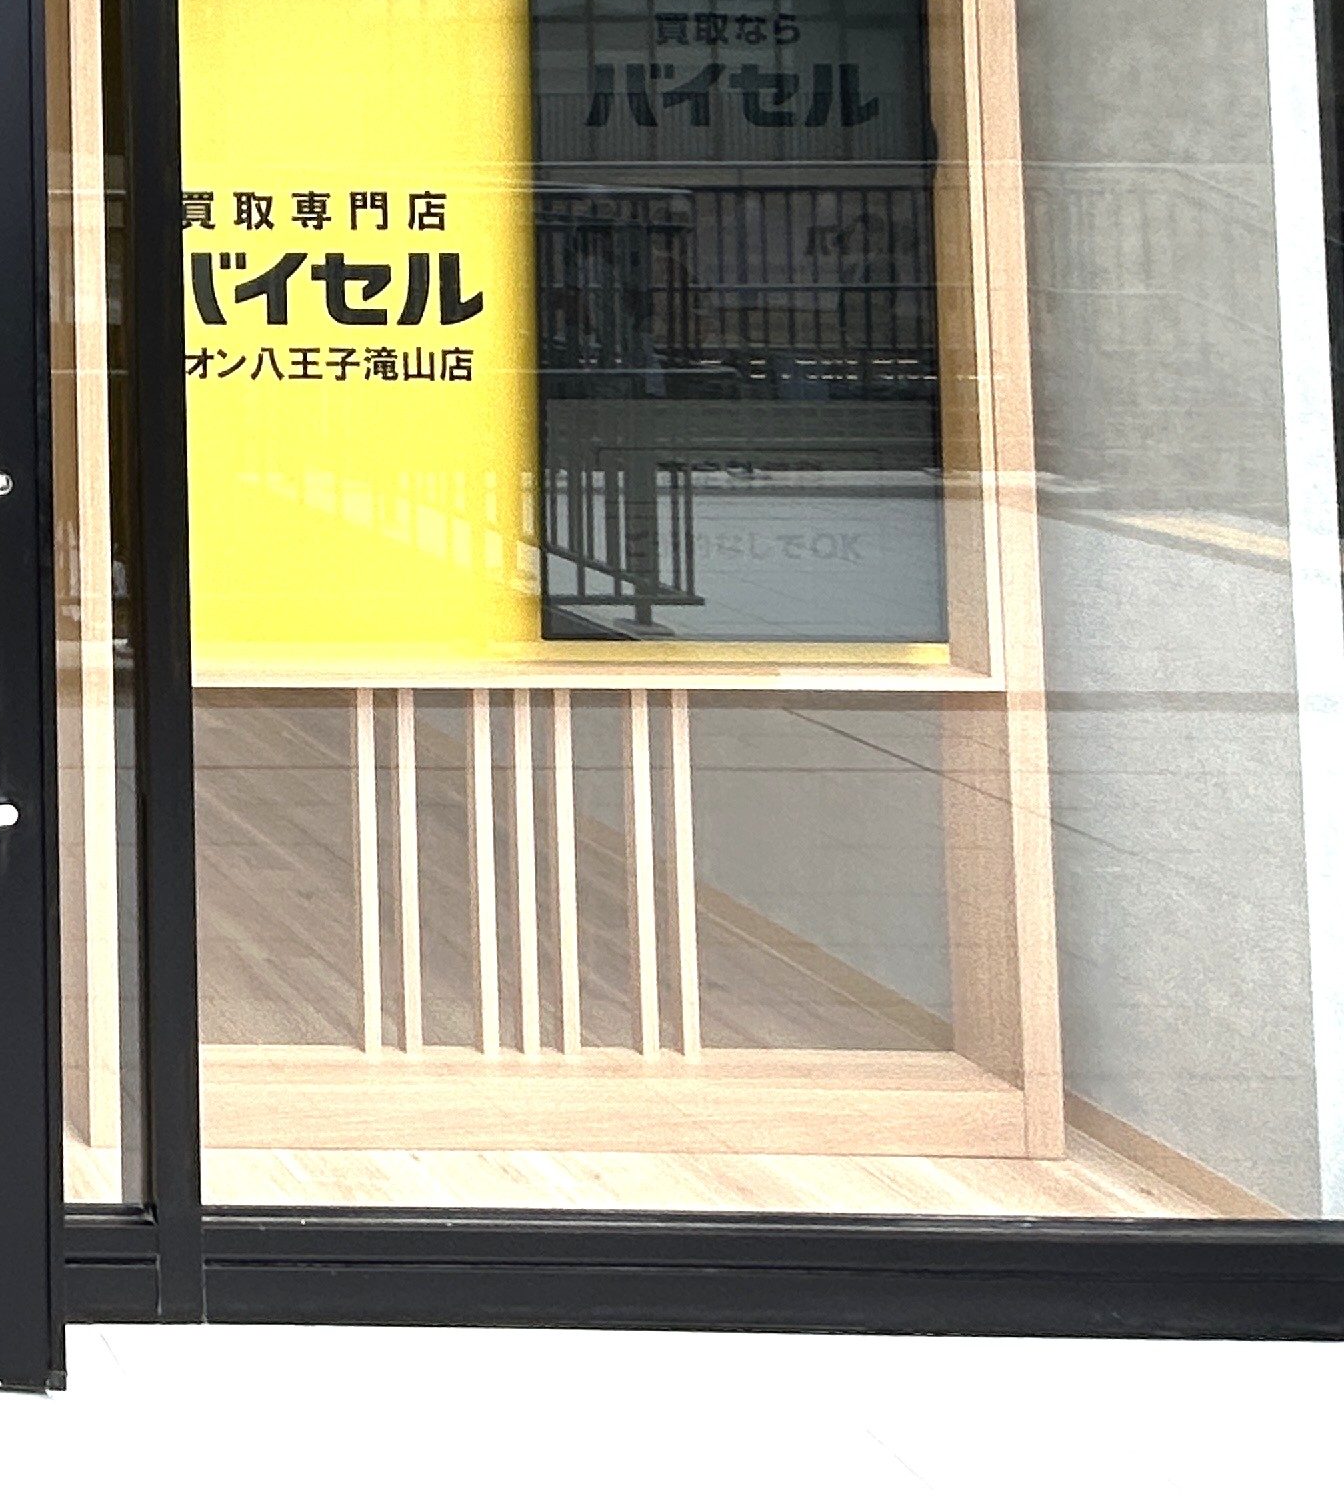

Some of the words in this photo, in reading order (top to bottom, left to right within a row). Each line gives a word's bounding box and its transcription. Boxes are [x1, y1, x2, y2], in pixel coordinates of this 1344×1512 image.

[654, 11, 801, 46] 買取なら
[586, 62, 880, 128] バイセル
[181, 190, 448, 231] 買取専門店
[191, 252, 484, 326] バイセル
[185, 346, 474, 382] オン八王子滝山店
